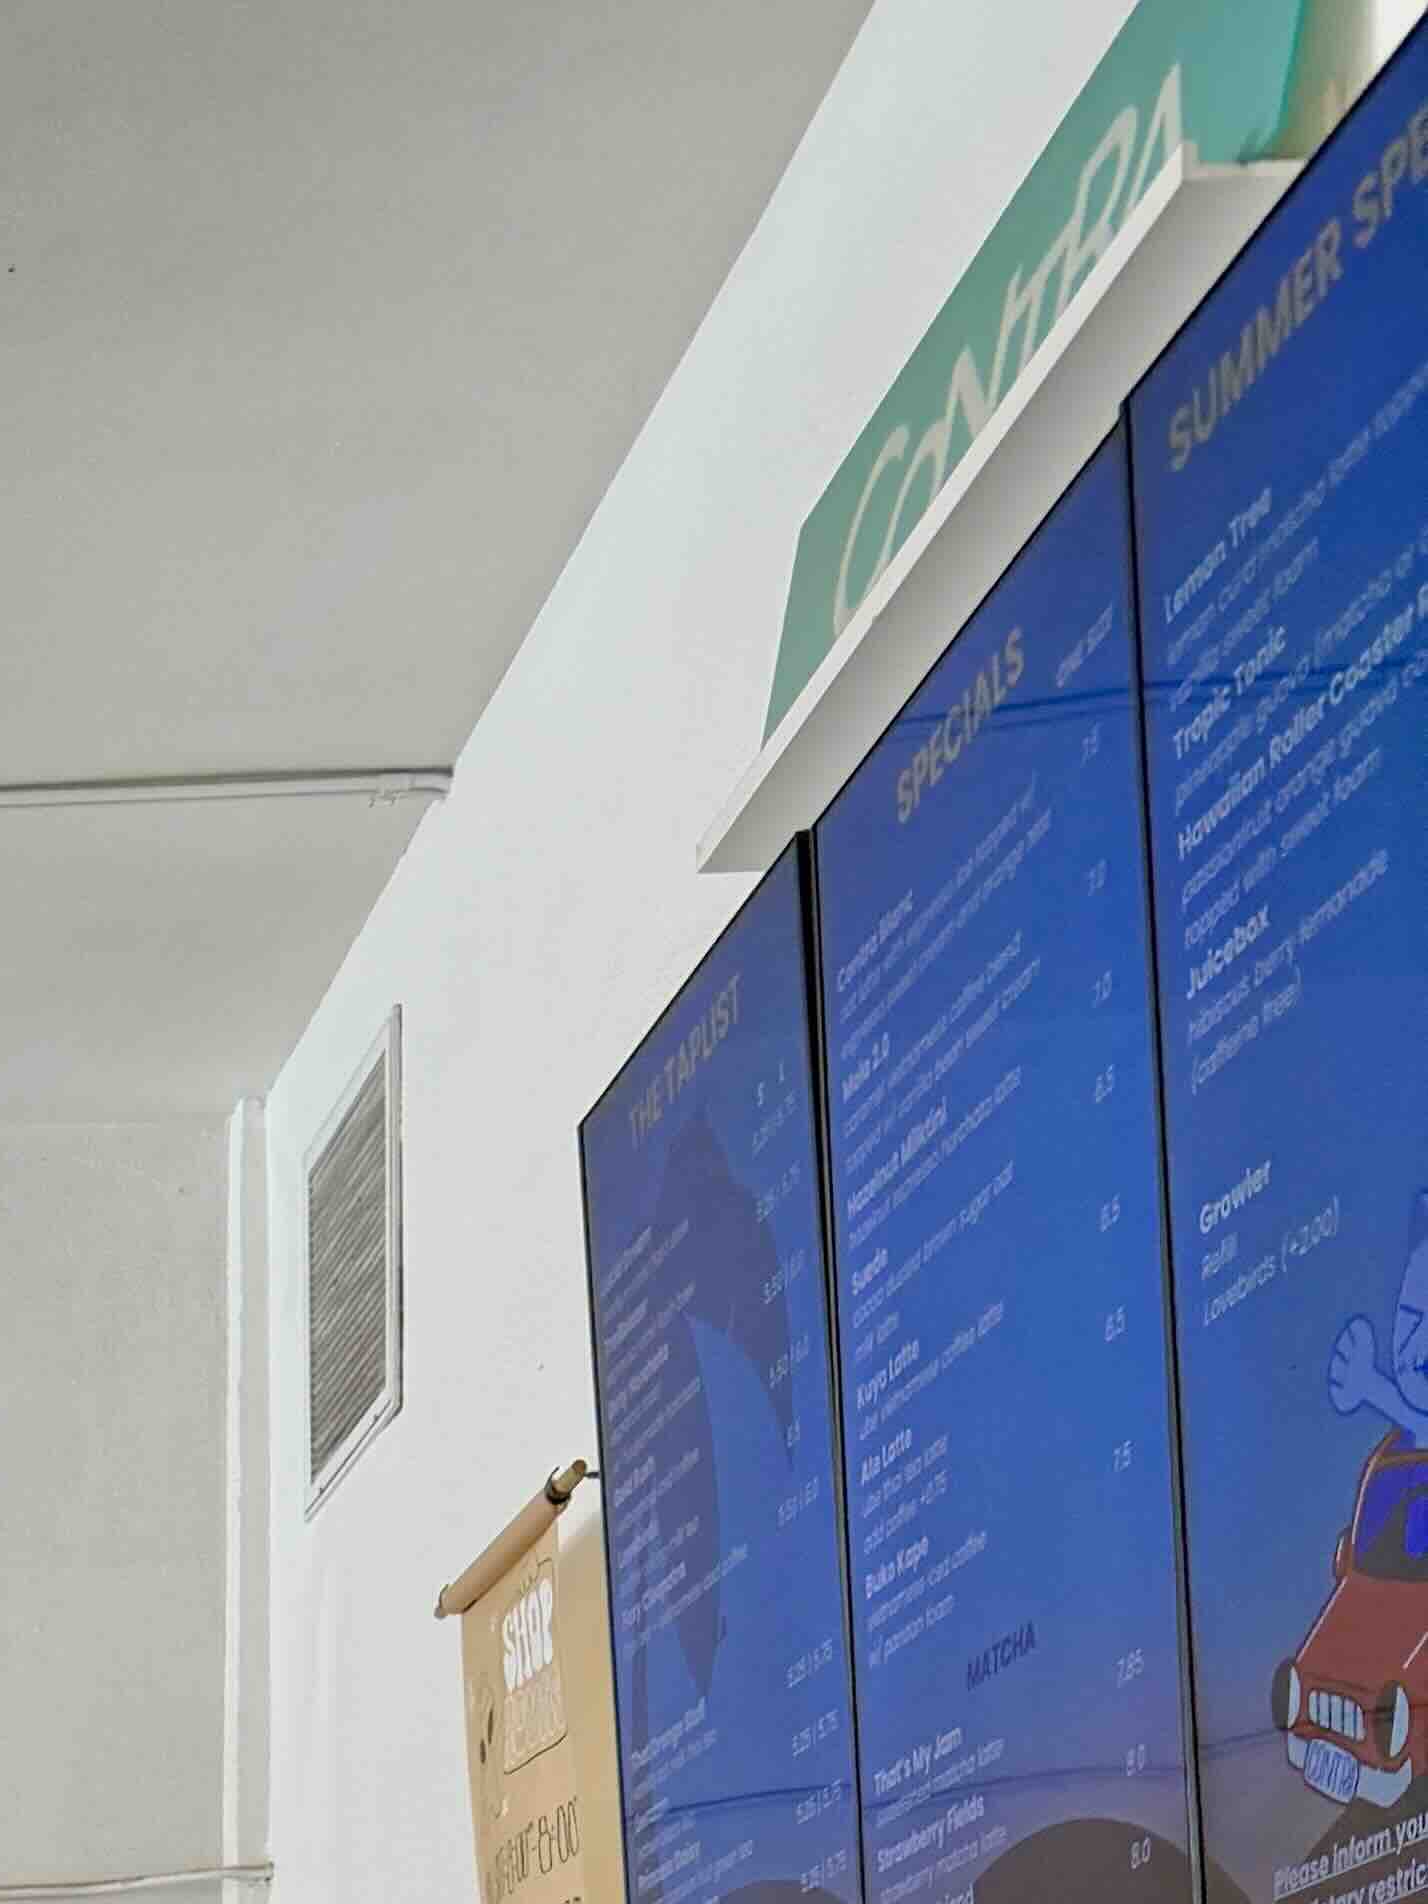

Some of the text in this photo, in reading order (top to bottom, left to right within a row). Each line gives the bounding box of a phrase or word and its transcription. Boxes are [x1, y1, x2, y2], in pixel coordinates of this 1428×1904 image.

[1168, 206, 1341, 483] SUMMER
[1165, 477, 1270, 624] Lemon Tree
[896, 619, 1023, 828] SPECIALS
[1174, 614, 1285, 770] Tropic Tonic
[1179, 594, 1412, 860] Hawaiian Roller Coaster
[1187, 897, 1267, 999] Juicebox
[629, 1074, 661, 1152] THE
[664, 970, 741, 1110] TAPLIST
[847, 1146, 898, 1220] Hazelnut
[1200, 1152, 1270, 1235] Growler
[852, 1241, 887, 1295] Suede
[1203, 1252, 1275, 1326] Lovebirds
[857, 1335, 918, 1415] Kuya Latte
[883, 1423, 911, 1467] Latte
[866, 1531, 928, 1598] Buko Kape
[967, 1620, 1035, 1689] MATCHA
[875, 1722, 961, 1796] That's My Jam
[878, 1791, 984, 1879] Strawberry Fields
[1130, 1835, 1150, 1871] 8.0
[1274, 1850, 1328, 1896] Please
[1333, 1823, 1390, 1872] inform
